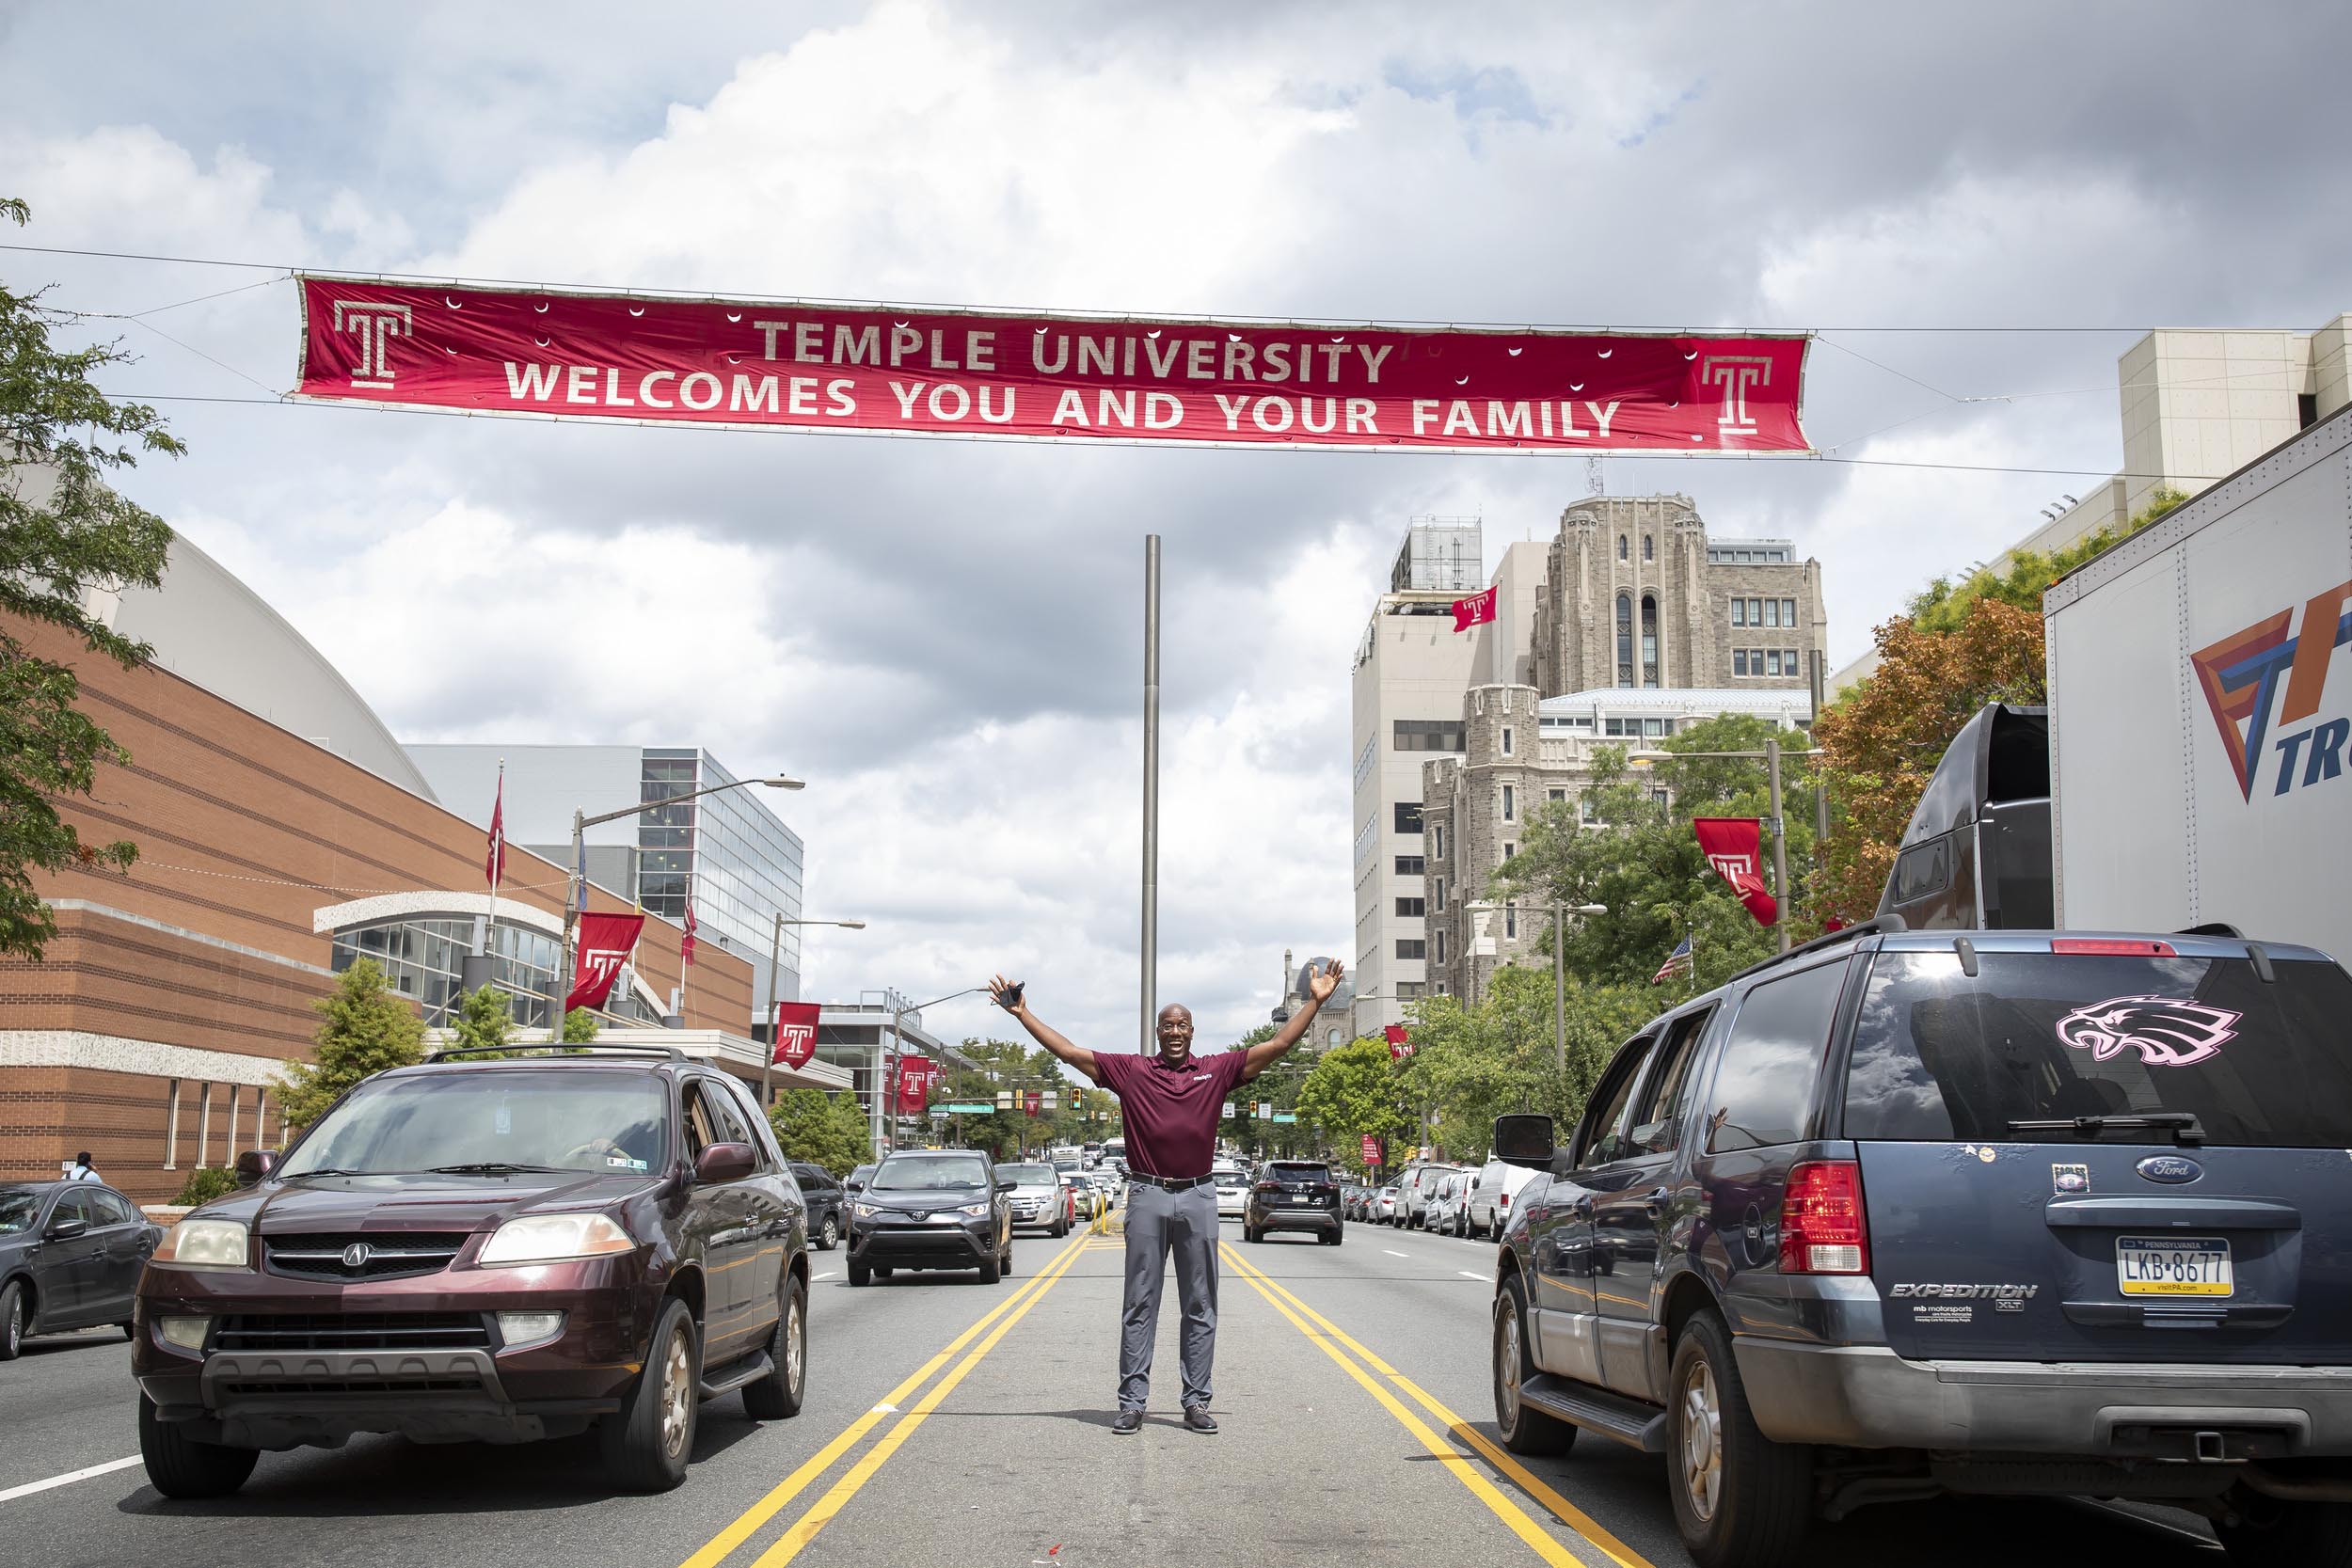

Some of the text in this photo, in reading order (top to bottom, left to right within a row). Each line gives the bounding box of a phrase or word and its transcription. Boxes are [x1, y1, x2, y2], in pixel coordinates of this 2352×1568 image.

[754, 321, 1394, 383] TEMPLE UNIVERSITY
[504, 361, 1621, 439] WELCOMES YOU AND YOUR FAMILY
[2153, 1160, 2189, 1176] Ford
[2145, 1241, 2201, 1249] PENNSYLVANIA
[1888, 1283, 2039, 1299] EXPEDITION
[1928, 1305, 1973, 1313] motorsports
[1998, 1301, 2022, 1309] XLT
